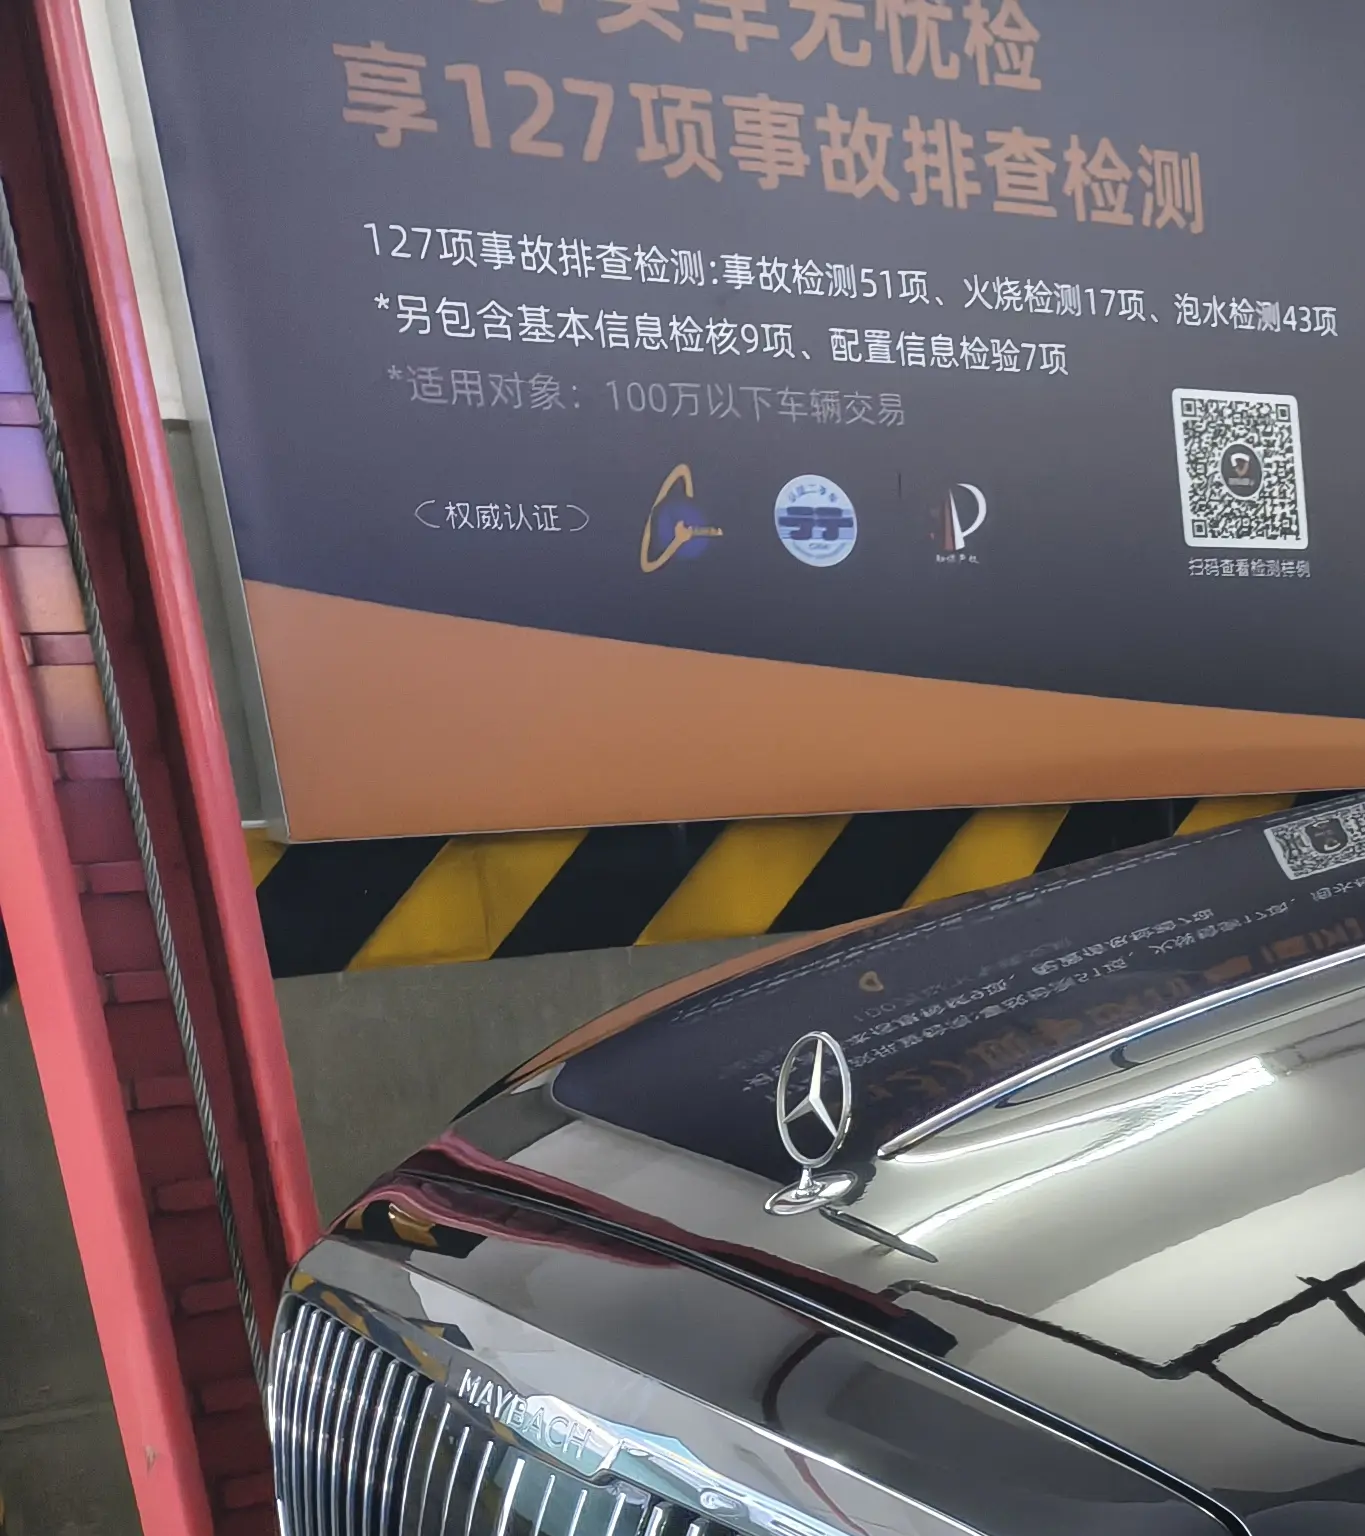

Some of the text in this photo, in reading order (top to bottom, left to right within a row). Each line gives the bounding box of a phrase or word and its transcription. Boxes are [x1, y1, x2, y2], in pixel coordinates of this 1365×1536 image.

[333, 40, 1206, 236] 享127项事故排查检测
[444, 501, 562, 532] 权威认证
[458, 1368, 592, 1459] MAYBACH
